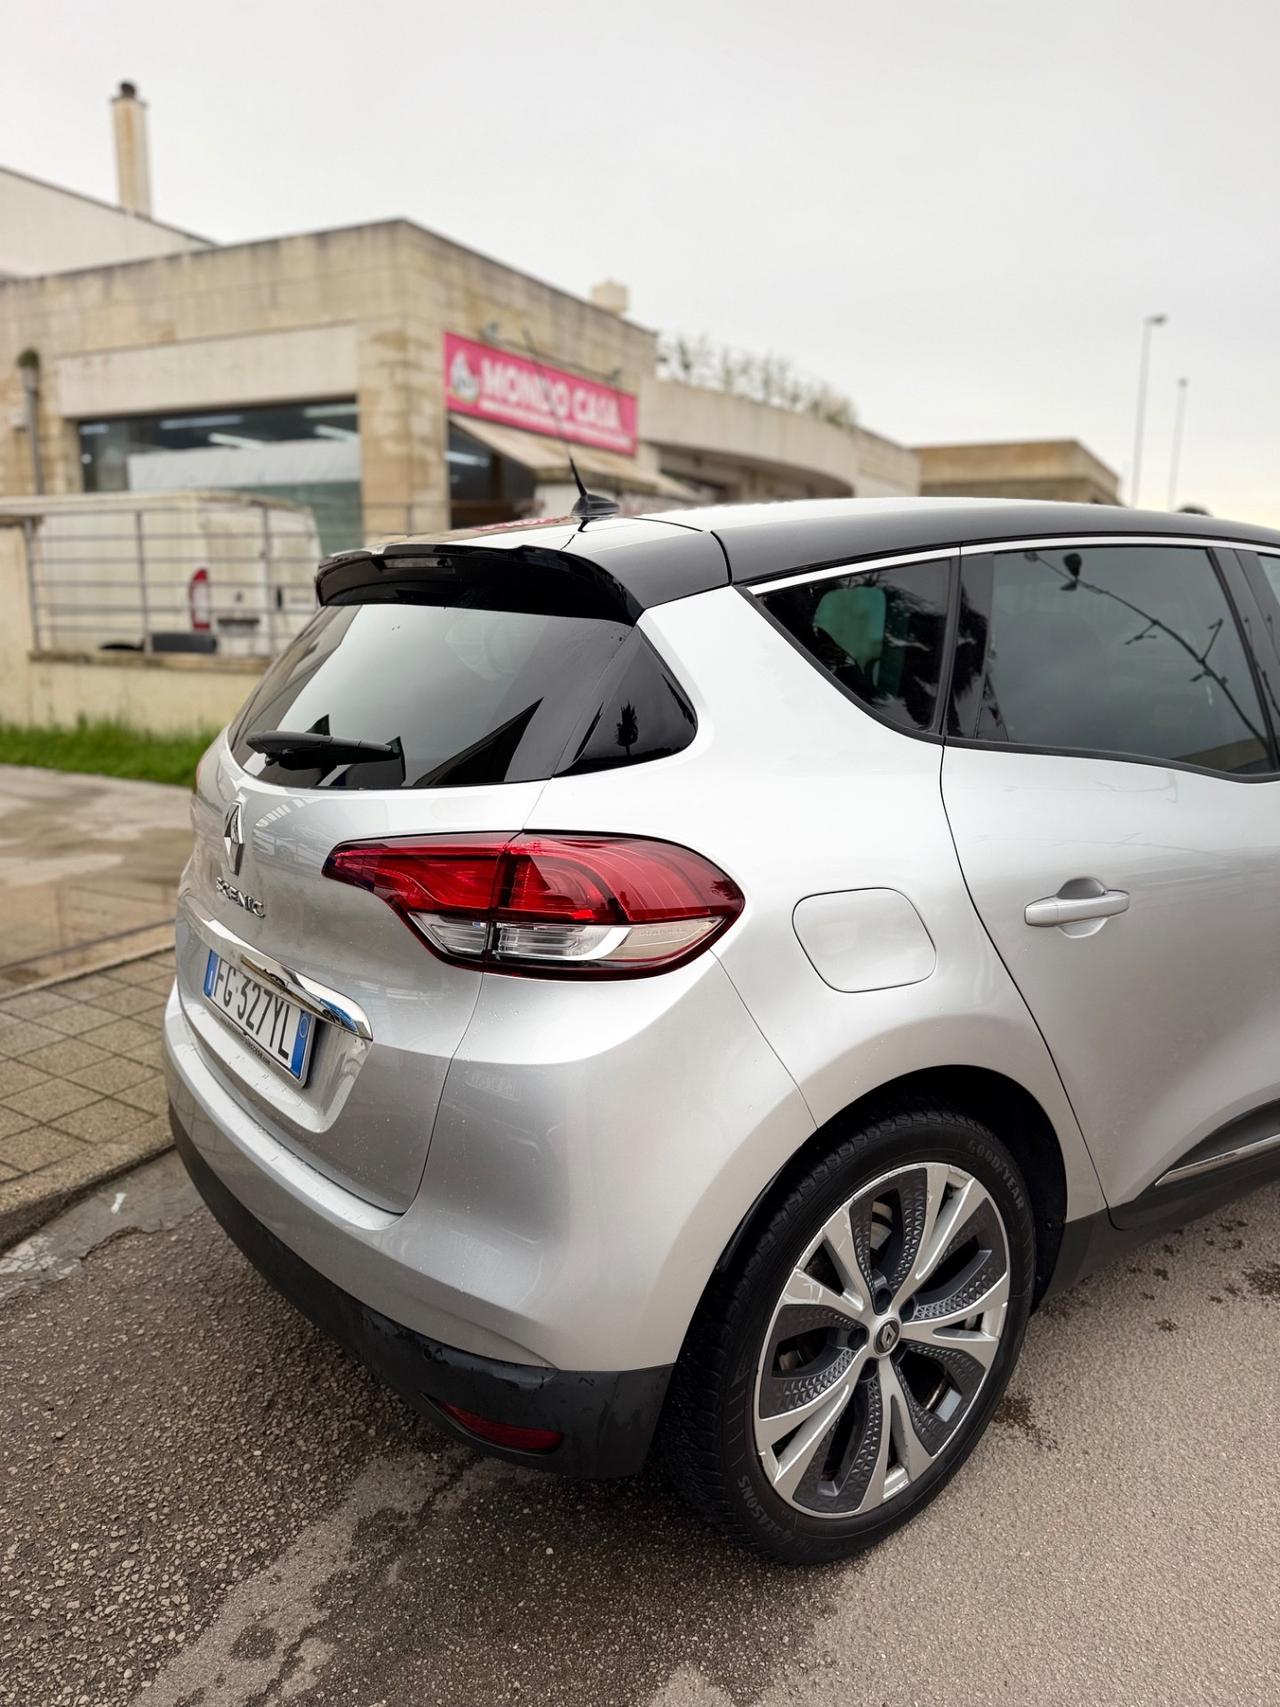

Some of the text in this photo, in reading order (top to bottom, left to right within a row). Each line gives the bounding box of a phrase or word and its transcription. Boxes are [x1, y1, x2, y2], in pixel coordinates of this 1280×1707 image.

[480, 358, 570, 417] MONDO
[573, 388, 622, 431] CASA
[968, 1140, 1025, 1210] GOODYEAR
